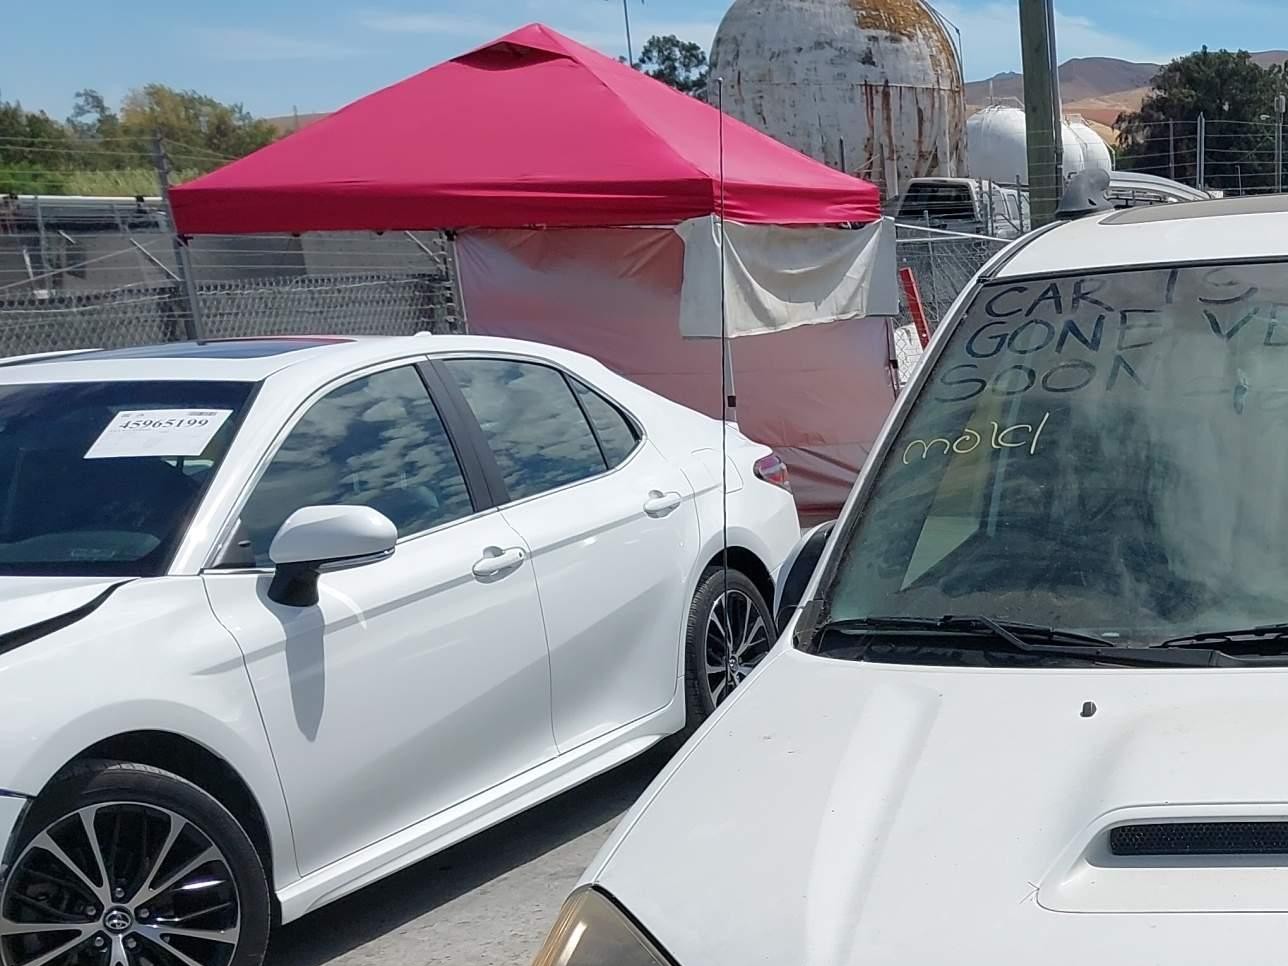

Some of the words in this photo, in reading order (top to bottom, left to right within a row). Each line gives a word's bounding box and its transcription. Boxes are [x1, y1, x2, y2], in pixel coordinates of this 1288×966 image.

[986, 279, 1114, 318] CAR
[966, 308, 1161, 358] GONE
[934, 354, 1148, 402] SOON
[119, 418, 209, 430] 45965199
